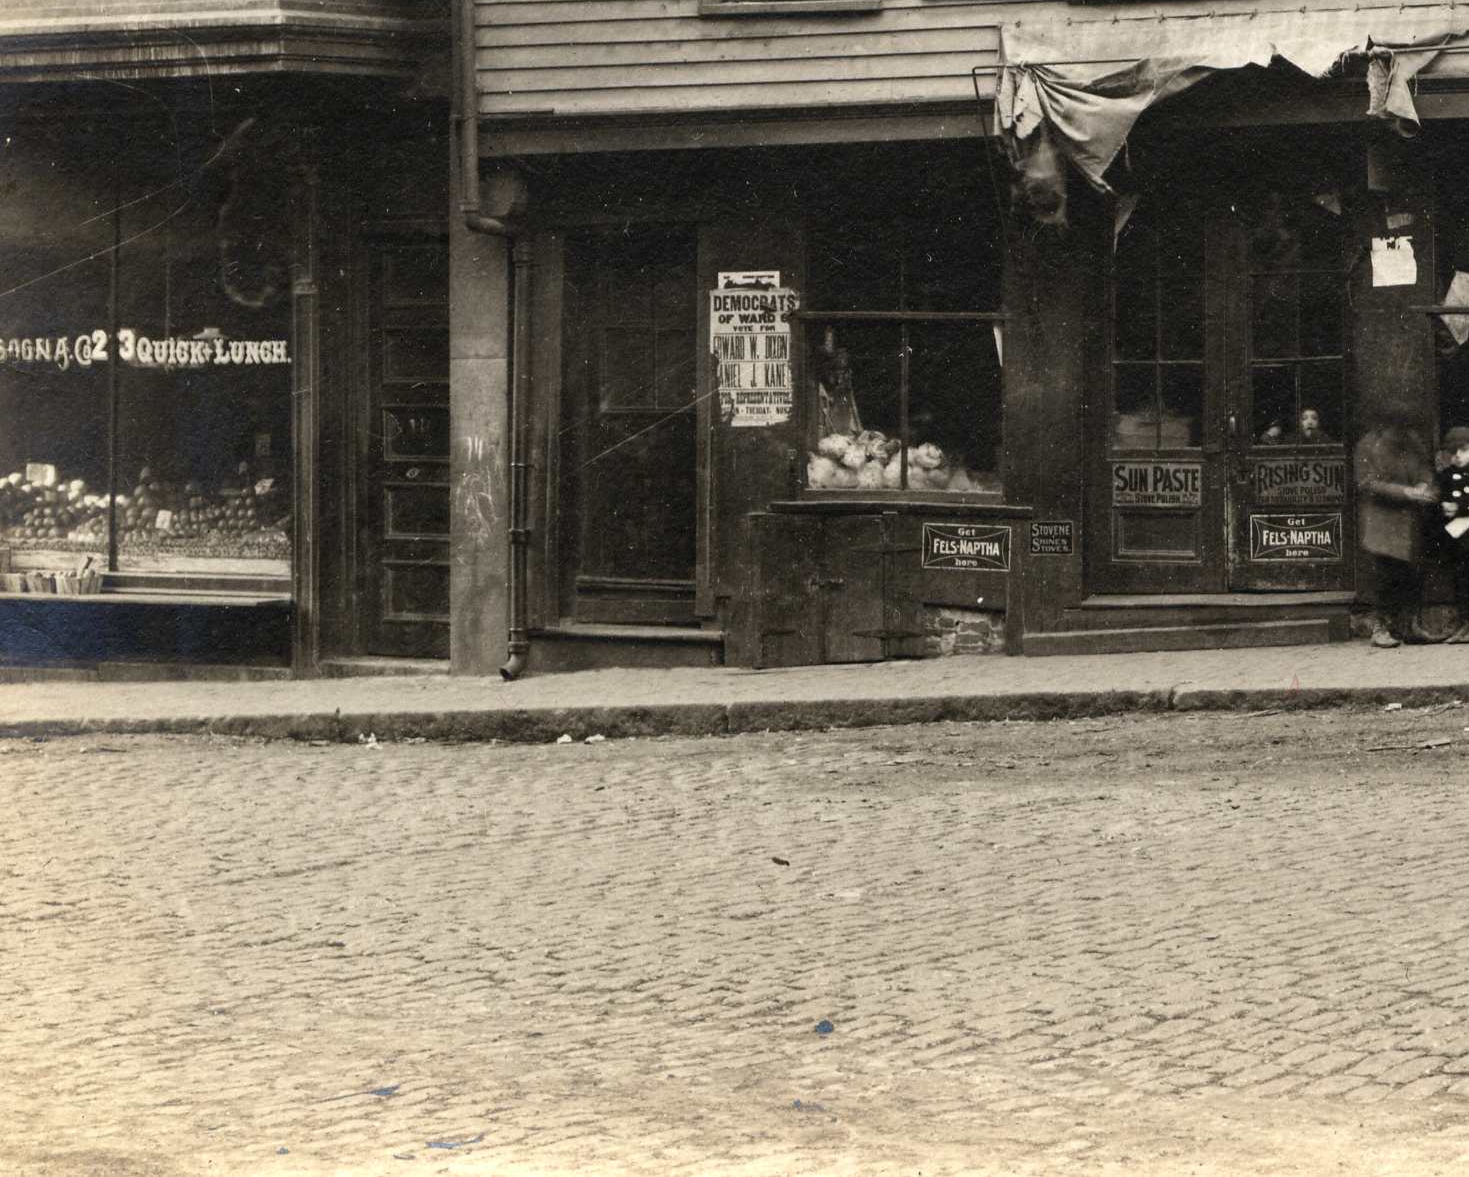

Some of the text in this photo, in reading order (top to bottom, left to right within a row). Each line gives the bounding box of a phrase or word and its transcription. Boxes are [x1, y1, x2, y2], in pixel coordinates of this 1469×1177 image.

[713, 294, 795, 312] DEMOCRATS
[718, 314, 735, 324] OF
[739, 314, 775, 324] WARD
[136, 336, 207, 365] QUICK
[765, 336, 788, 360] DIXON
[765, 363, 787, 388] KANE
[1114, 465, 1199, 492] SUN PASTE
[1258, 463, 1345, 495] RISING SUN
[1031, 523, 1071, 537] STOVENE
[1287, 518, 1305, 526] Get
[957, 527, 976, 536] Get
[1285, 548, 1310, 557] here
[954, 557, 978, 567] here
